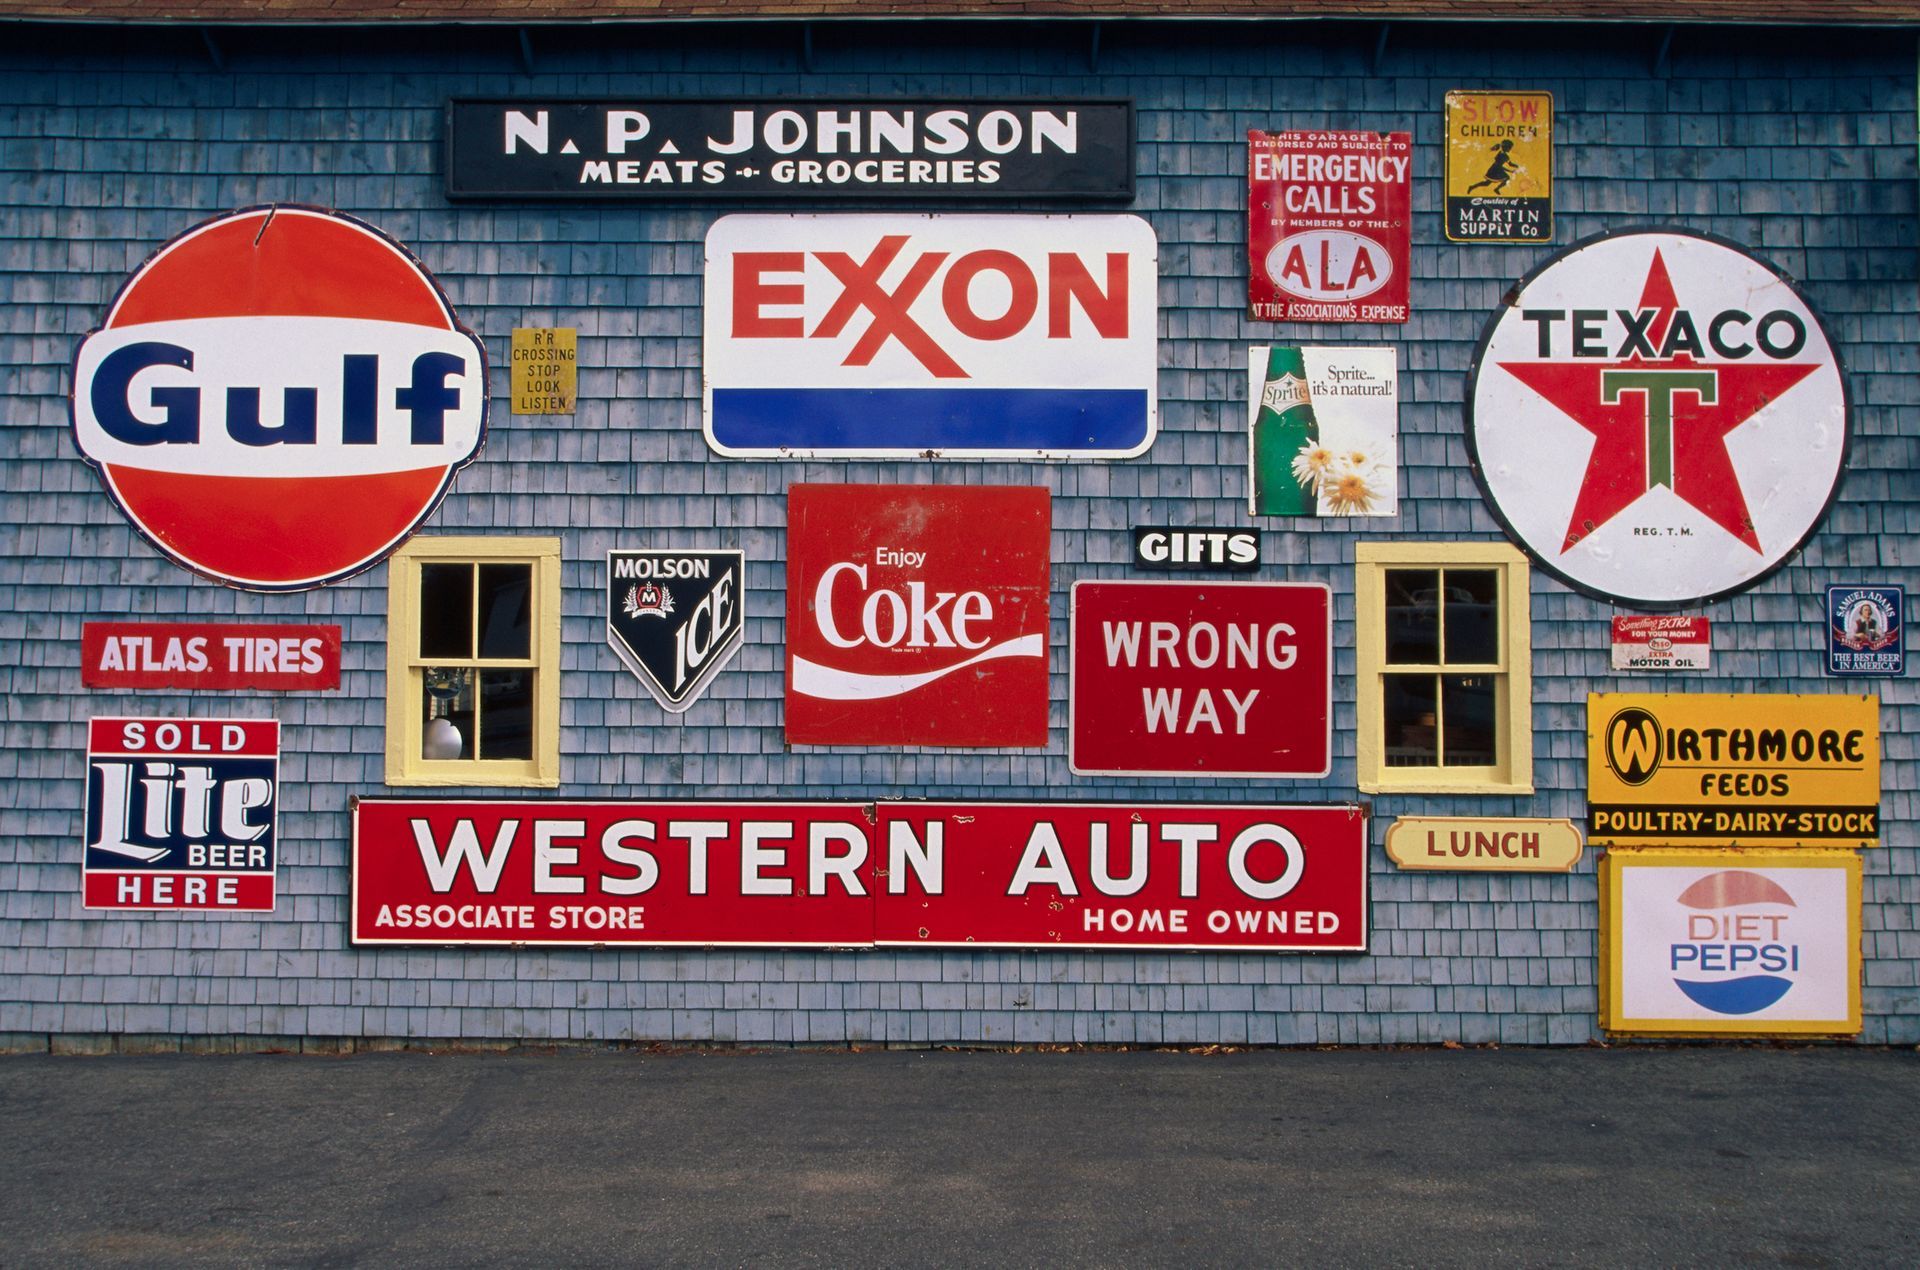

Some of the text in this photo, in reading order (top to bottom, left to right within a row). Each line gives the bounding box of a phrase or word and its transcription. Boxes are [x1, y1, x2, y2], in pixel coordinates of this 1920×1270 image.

[1463, 98, 1539, 123] SLOW
[505, 110, 1078, 154] N. P. JOHNSON
[1308, 133, 1369, 142] GARAGE
[1461, 125, 1538, 137] CHILDREN
[1255, 141, 1314, 149] ENDORSED
[580, 160, 1001, 184] MEATS GROCERIES
[1255, 153, 1409, 184] EMERGENCY
[1285, 186, 1376, 214] CALLS
[1271, 218, 1389, 228] BY MEMBERS OF THE
[1460, 208, 1539, 223] MARTIN
[1461, 222, 1512, 236] SUPPLY
[1281, 240, 1377, 292] ALA
[731, 235, 1130, 378] EXXON
[1265, 303, 1284, 318] THE
[1287, 303, 1357, 319] ASSOCIATION'S
[1361, 304, 1406, 321] EXPENSE
[1522, 308, 1807, 360] TEXACO
[513, 349, 575, 361] CROSSING
[528, 365, 561, 377] STOP
[91, 341, 467, 447] Gulf
[527, 381, 560, 393] LOOK
[1265, 385, 1306, 405] Sprite
[1313, 380, 1393, 397] it's a natural!
[522, 397, 566, 409] LISTEN
[1634, 527, 1663, 536] REG.
[876, 547, 926, 568] Enjoy
[1139, 533, 1258, 563] GIFTS
[615, 559, 710, 579] MOLSON
[815, 562, 993, 650] Coke
[1836, 590, 1896, 618] SAMUEL ADAMS
[674, 567, 734, 693] ICE
[1619, 617, 1691, 631] Something EXTRA
[223, 637, 323, 674] TIRES
[1103, 621, 1298, 670] WRONG
[1834, 653, 1900, 662] THE BEST BEER
[1630, 659, 1694, 667] MOTOR OIL
[1840, 661, 1894, 670] IN AMERICA
[1142, 688, 1260, 735] WAY
[122, 722, 246, 751] SOLD
[1611, 719, 1864, 774] WIRTHMORE
[1701, 774, 1789, 797] FEEDS
[90, 762, 273, 863] Lite
[188, 844, 266, 867] BEER
[1427, 831, 1540, 858] LUNCH
[410, 818, 1304, 900] WESTERN AUTO
[117, 876, 239, 905] HERE
[374, 905, 645, 929] ASSOCIATE STORE
[1083, 909, 1340, 935] HOME OWNED
[1688, 915, 1789, 941] DIET
[1670, 944, 1799, 971] PEPSI
